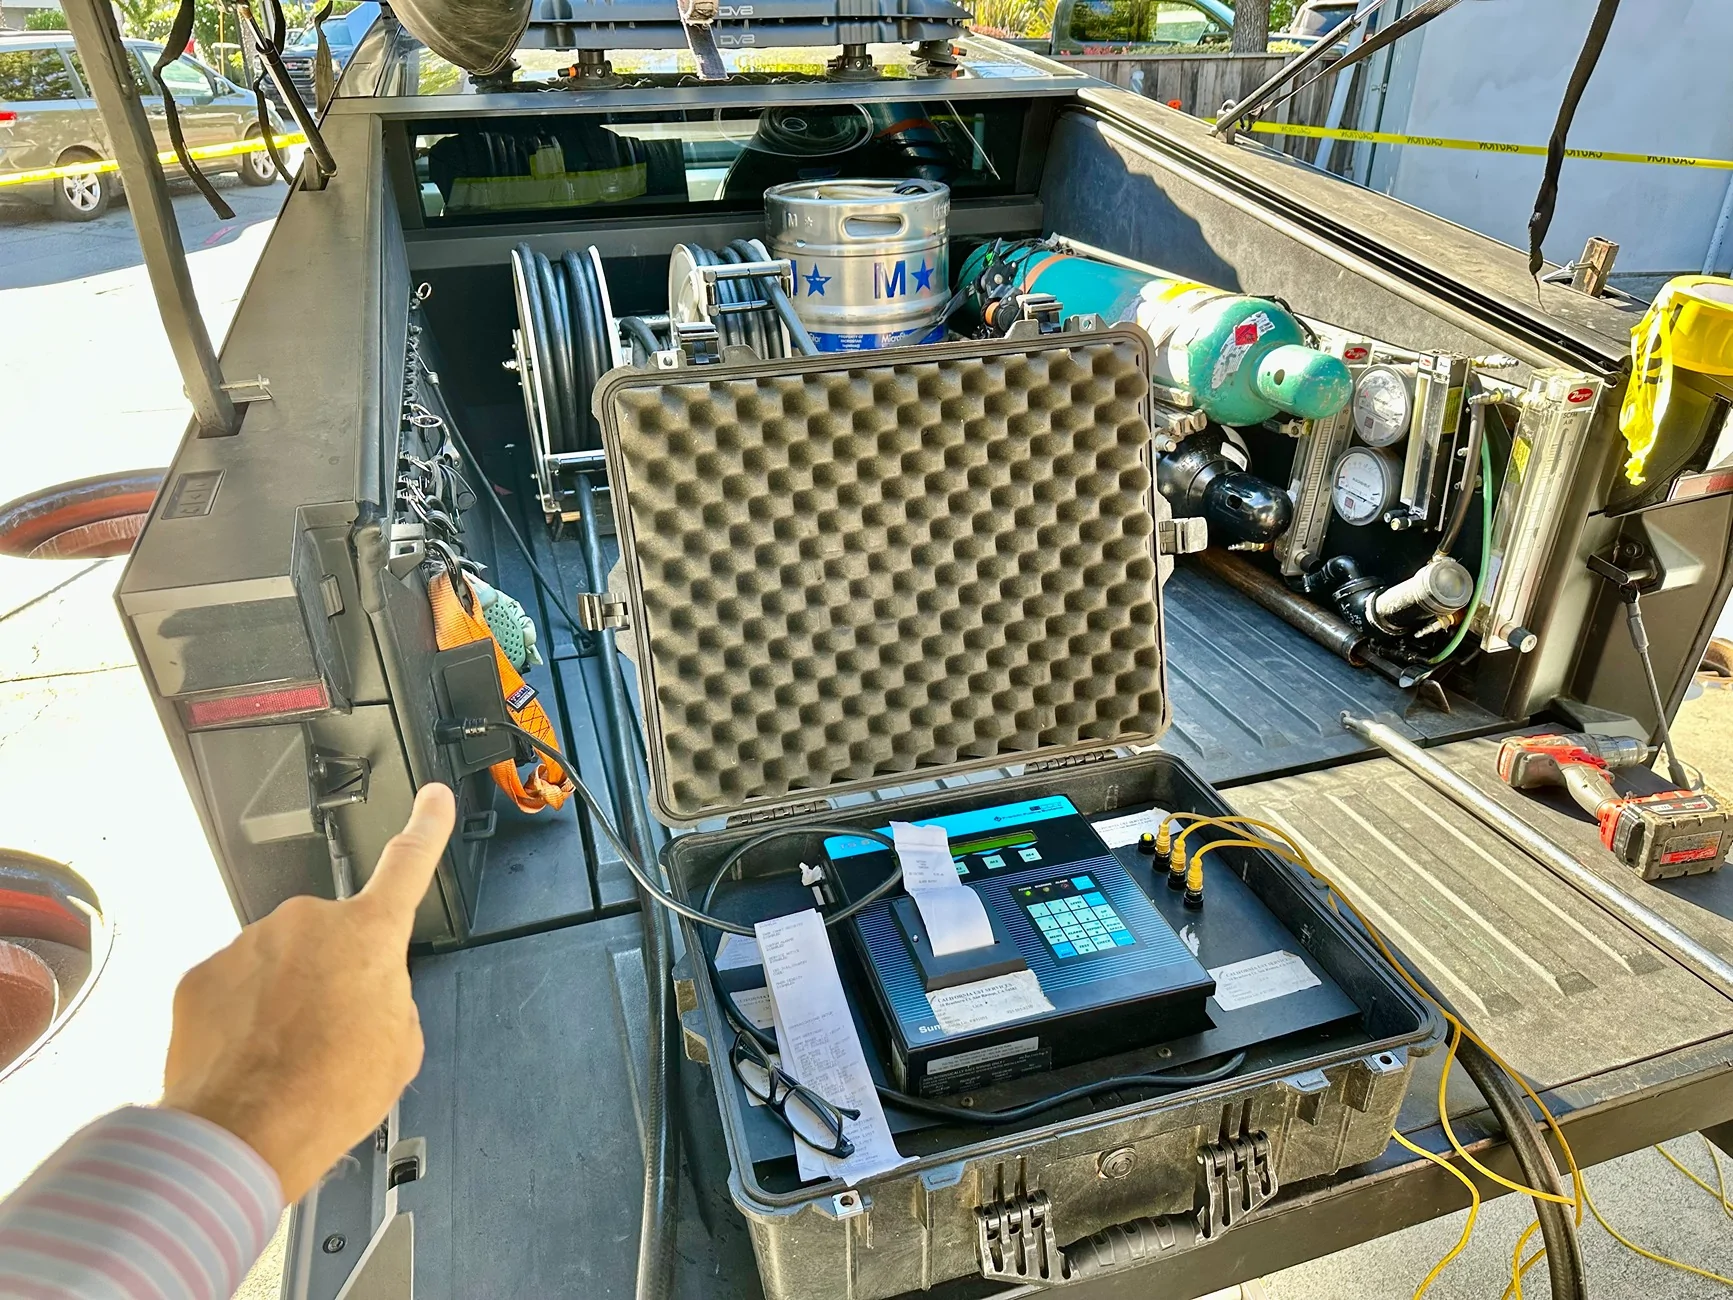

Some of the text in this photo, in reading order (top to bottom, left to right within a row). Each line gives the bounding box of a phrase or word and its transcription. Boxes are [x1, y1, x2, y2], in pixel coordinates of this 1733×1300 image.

[718, 5, 754, 17] DV8
[720, 34, 756, 45] DV8
[873, 260, 907, 299] M
[938, 991, 973, 1003] CALIFORNIA
[985, 982, 1013, 994] SERVICES
